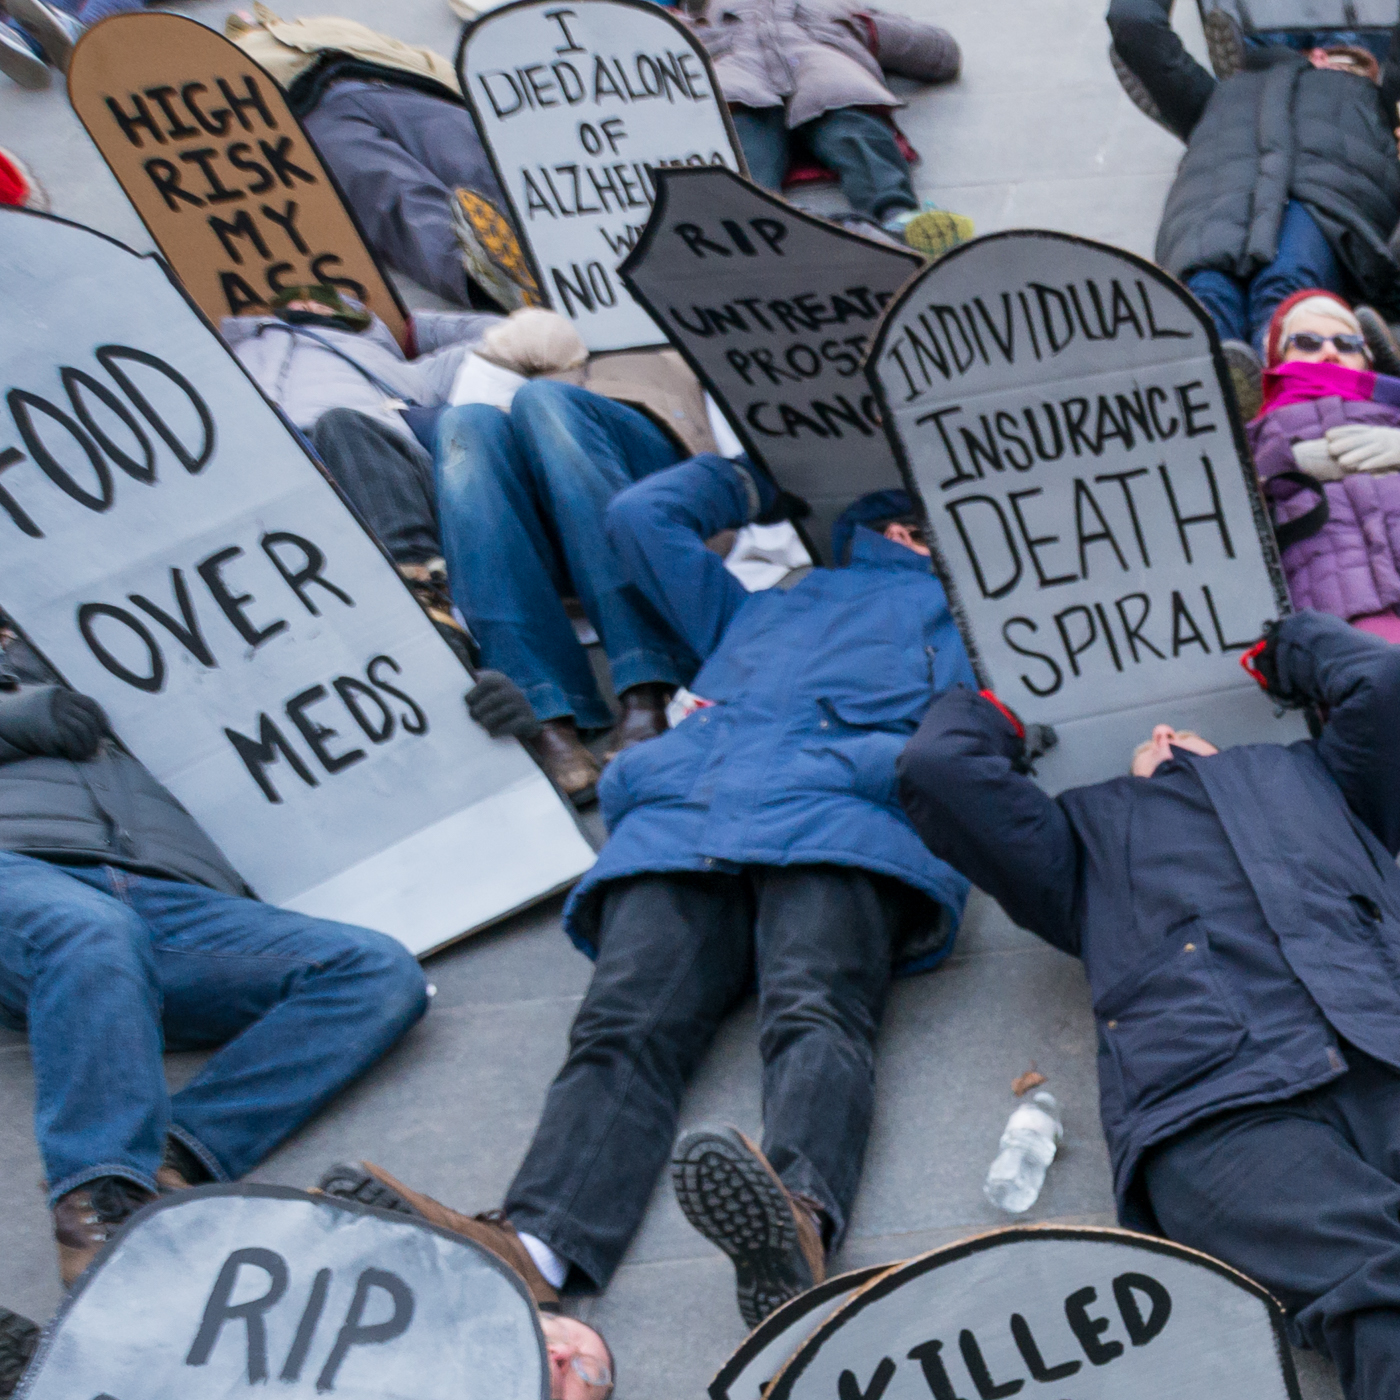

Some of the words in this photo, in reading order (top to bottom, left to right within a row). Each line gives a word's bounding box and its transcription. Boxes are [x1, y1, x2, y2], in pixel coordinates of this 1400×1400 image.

[545, 10, 586, 57] I
[104, 75, 279, 148] HIGH
[479, 60, 586, 121] DIED
[594, 49, 711, 106] ALONE
[142, 136, 318, 212] RISK
[579, 118, 628, 155] OF
[206, 200, 311, 265] MY
[673, 218, 789, 258] RIP
[551, 261, 620, 319] NO
[886, 278, 1194, 403] INDIVIDUAL
[915, 380, 1217, 490] INSURANCE
[945, 453, 1237, 600] DEATH
[77, 531, 356, 694] OVER
[1002, 584, 1265, 697] SPIRAL
[223, 654, 430, 805] MEDS
[185, 1246, 417, 1395] RIP
